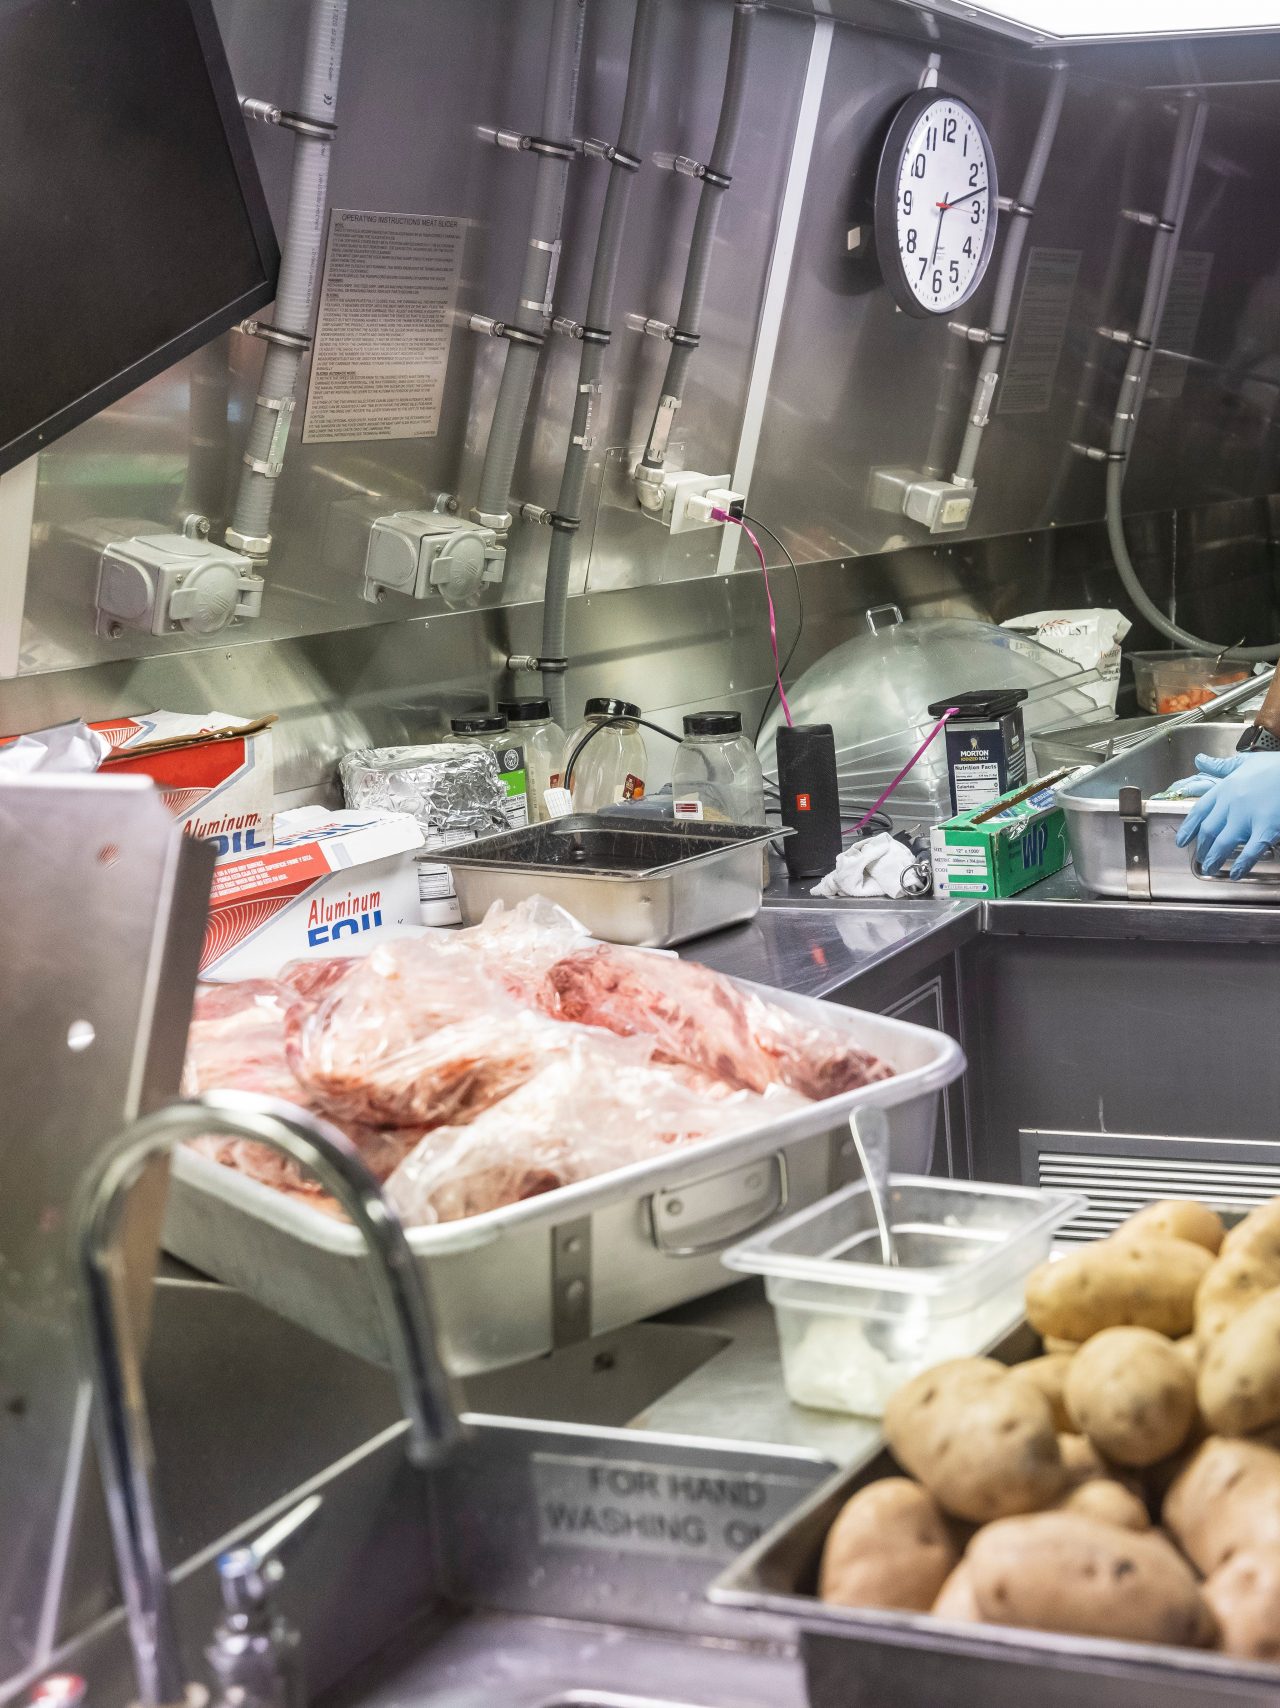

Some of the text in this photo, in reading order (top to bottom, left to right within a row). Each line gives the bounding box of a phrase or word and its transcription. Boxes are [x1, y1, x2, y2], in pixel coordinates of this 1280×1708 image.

[927, 126, 937, 151] 11
[943, 118, 957, 143] 12
[963, 134, 968, 157] 1
[911, 153, 925, 178] 10
[969, 164, 979, 187] 2
[903, 190, 912, 215] 9
[971, 200, 980, 225] 3
[342, 214, 458, 228] OPERATING INSTRUCTIONS MEAT SLICER
[906, 229, 917, 253] 8
[963, 236, 972, 258] 4
[919, 258, 928, 280] 7
[932, 269, 941, 293] 6
[949, 260, 959, 283] 5
[184, 812, 258, 839] Aluminum
[1023, 822, 1048, 869] WP
[308, 891, 381, 928] Aluminum
[587, 1466, 768, 1510] FOR HAND
[545, 1501, 708, 1547] WASHING
